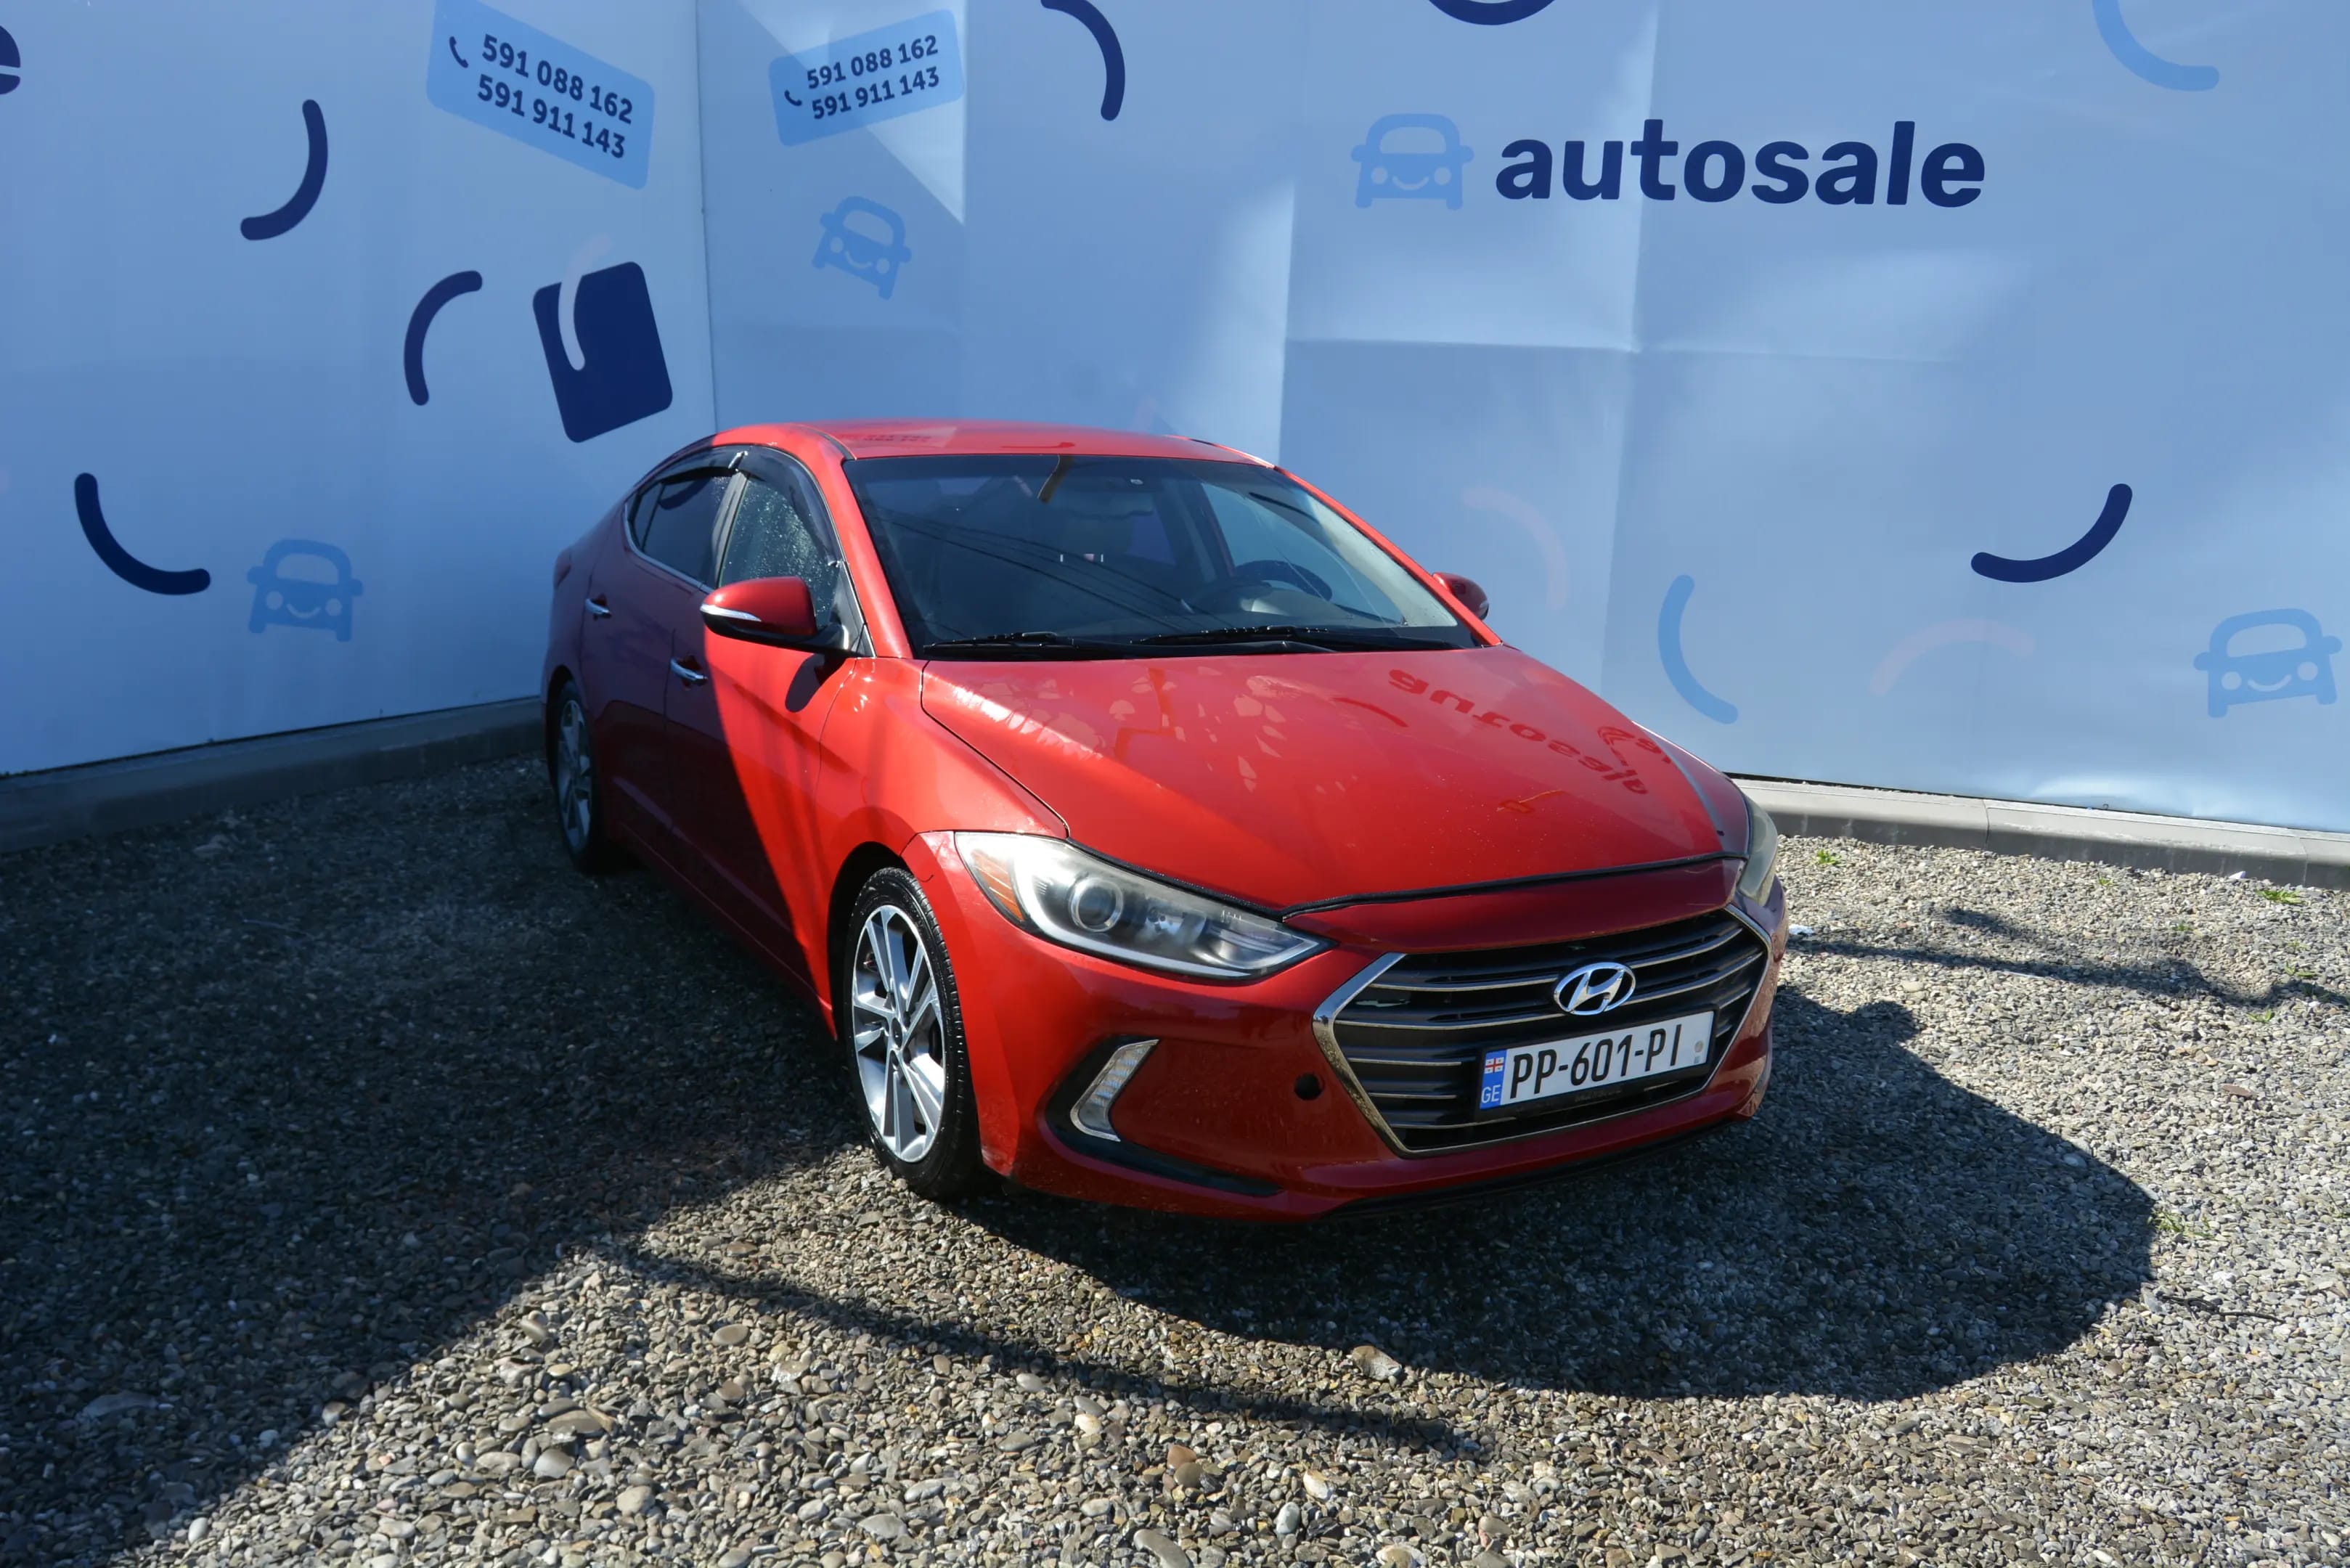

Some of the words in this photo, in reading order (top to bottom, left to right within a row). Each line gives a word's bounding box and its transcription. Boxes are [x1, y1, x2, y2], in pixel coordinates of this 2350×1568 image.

[482, 33, 529, 78] 591
[536, 60, 584, 102] 088
[589, 85, 633, 125] 162
[807, 62, 846, 89] 591
[851, 48, 892, 76] 088
[898, 35, 938, 63] 162
[812, 91, 852, 120] 591
[855, 80, 895, 107] 911
[899, 67, 939, 96] 143
[477, 73, 525, 117] 591
[532, 98, 576, 139] 911
[582, 121, 625, 159] 143
[1496, 118, 1986, 208] autosale
[1480, 1084, 1501, 1104] GE
[1509, 1024, 1682, 1099] PP-601-PI
